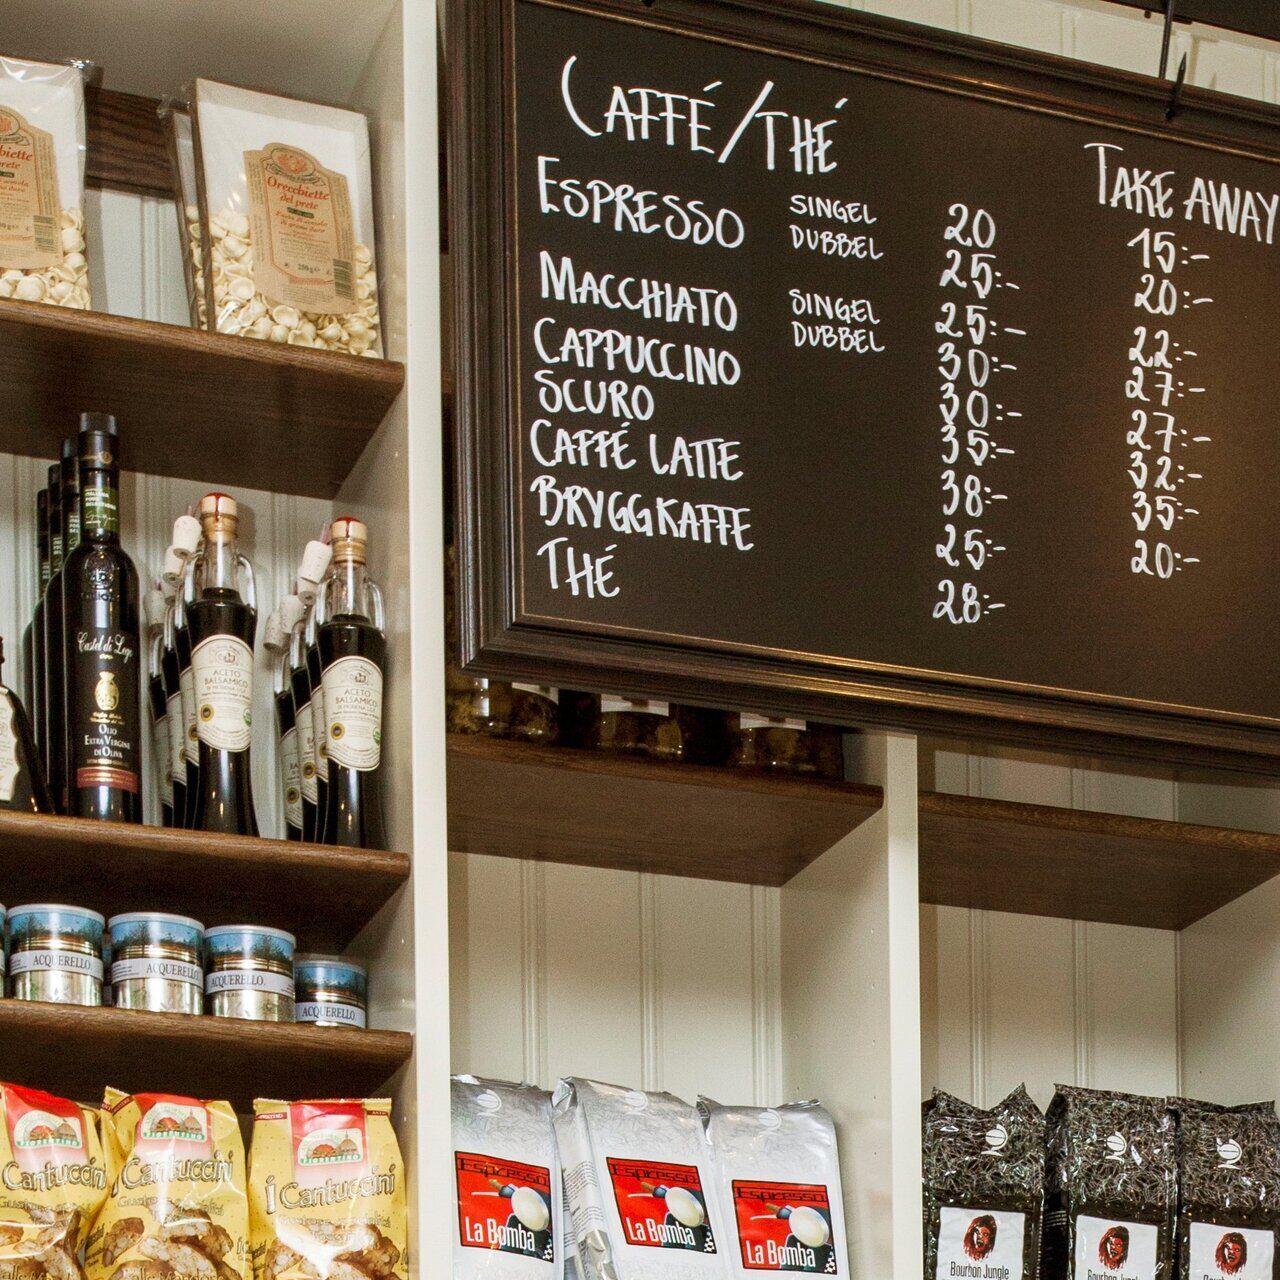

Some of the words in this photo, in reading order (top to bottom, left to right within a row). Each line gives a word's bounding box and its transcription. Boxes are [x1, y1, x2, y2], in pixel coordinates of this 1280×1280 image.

[537, 156, 744, 248] ESPRESSO
[790, 195, 877, 225] SINGEL
[1084, 143, 1175, 218] TAKE
[1183, 177, 1279, 244] AWAY
[789, 225, 883, 260] DUBBEL
[944, 203, 995, 248] 20
[1127, 230, 1210, 273] 15:-
[540, 250, 737, 331] MACCHIATO
[939, 252, 1019, 298] 25:-
[1134, 274, 1213, 315] 20:-
[789, 289, 880, 324] SINGEL
[935, 304, 1026, 342] 25:-
[534, 317, 740, 385] CAPPUCCINO
[792, 322, 885, 353] DUBBEL
[1129, 326, 1197, 369] 22:-
[938, 348, 1017, 386] 30:-
[1125, 370, 1205, 402] 27:-
[536, 371, 654, 421] SCURO
[530, 419, 636, 470] CAFFÉ
[650, 434, 743, 481] LATTE
[941, 426, 1015, 466] 35:-
[1126, 411, 1211, 453] 27:-
[1127, 451, 1202, 491] 32:-
[530, 475, 754, 552] BRYGGKAFFE
[941, 470, 1008, 518] 38:-
[1131, 491, 1199, 531] 35:-
[936, 526, 1006, 570] 25:-
[1131, 539, 1200, 578] 20:-
[537, 539, 620, 598] THÉ
[933, 581, 1005, 624] 28:-
[204, 677, 248, 688] BALSAMICO
[213, 669, 241, 678] ACETO
[345, 689, 371, 697] ACETO
[336, 697, 377, 708] BALSAMICO
[302, 1006, 355, 1021] ACQUERELLO
[121, 1150, 234, 1190] Cantuccini
[302, 1154, 360, 1164] FIORENTINO
[460, 1158, 547, 1186] Espresso
[610, 1164, 698, 1183] Espresso
[279, 1164, 396, 1210] Cantuccini
[736, 1187, 826, 1202] Espresso
[465, 1216, 484, 1242] La
[487, 1218, 535, 1252] Bomba
[626, 1218, 646, 1241] La
[648, 1219, 696, 1246] Bomba
[746, 1241, 762, 1264] La
[766, 1240, 816, 1267] Bomba
[950, 1262, 982, 1279] Bourbon
[983, 1264, 1009, 1280] Jungle
